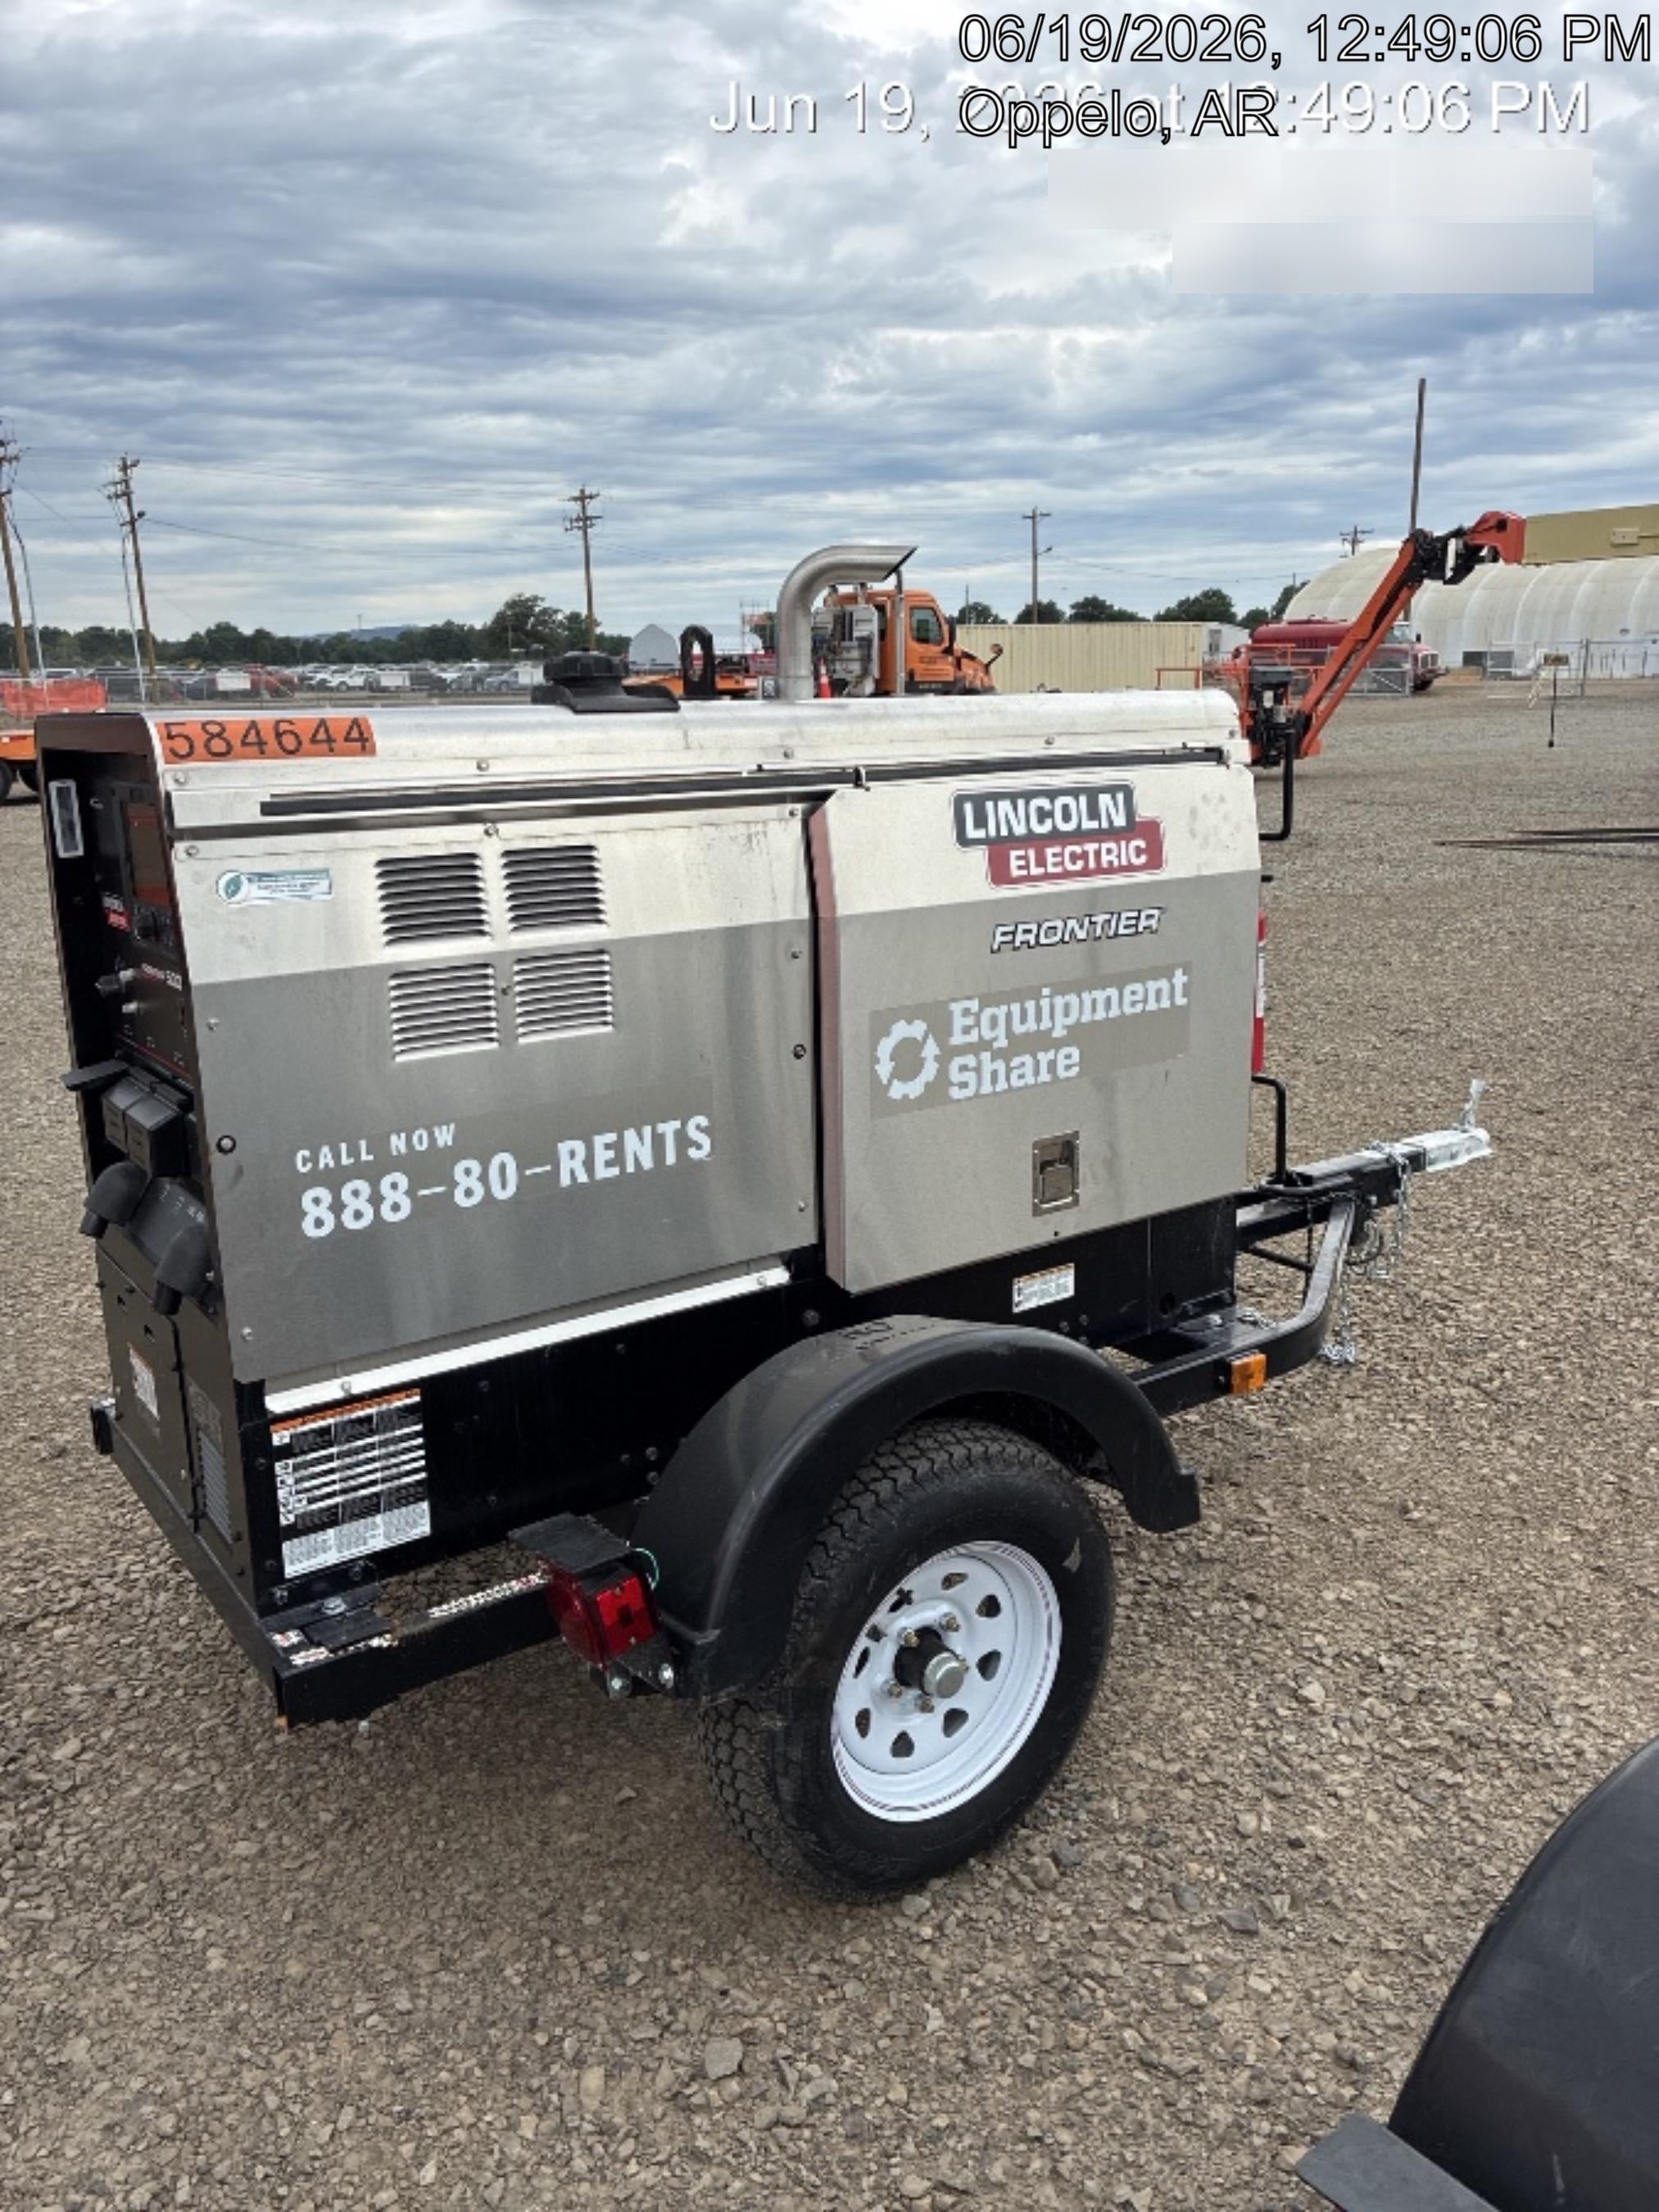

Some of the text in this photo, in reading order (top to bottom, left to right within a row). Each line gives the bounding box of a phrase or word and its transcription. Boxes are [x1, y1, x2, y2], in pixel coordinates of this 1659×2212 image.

[165, 718, 370, 759] 584644
[963, 791, 1126, 840] LINCOLN
[1009, 839, 1148, 877] ELECTRIC
[990, 907, 1163, 953] FRONTIER
[949, 968, 1188, 1049] Equipment
[948, 1046, 1080, 1100] Share
[295, 1122, 456, 1174] CALL NOW
